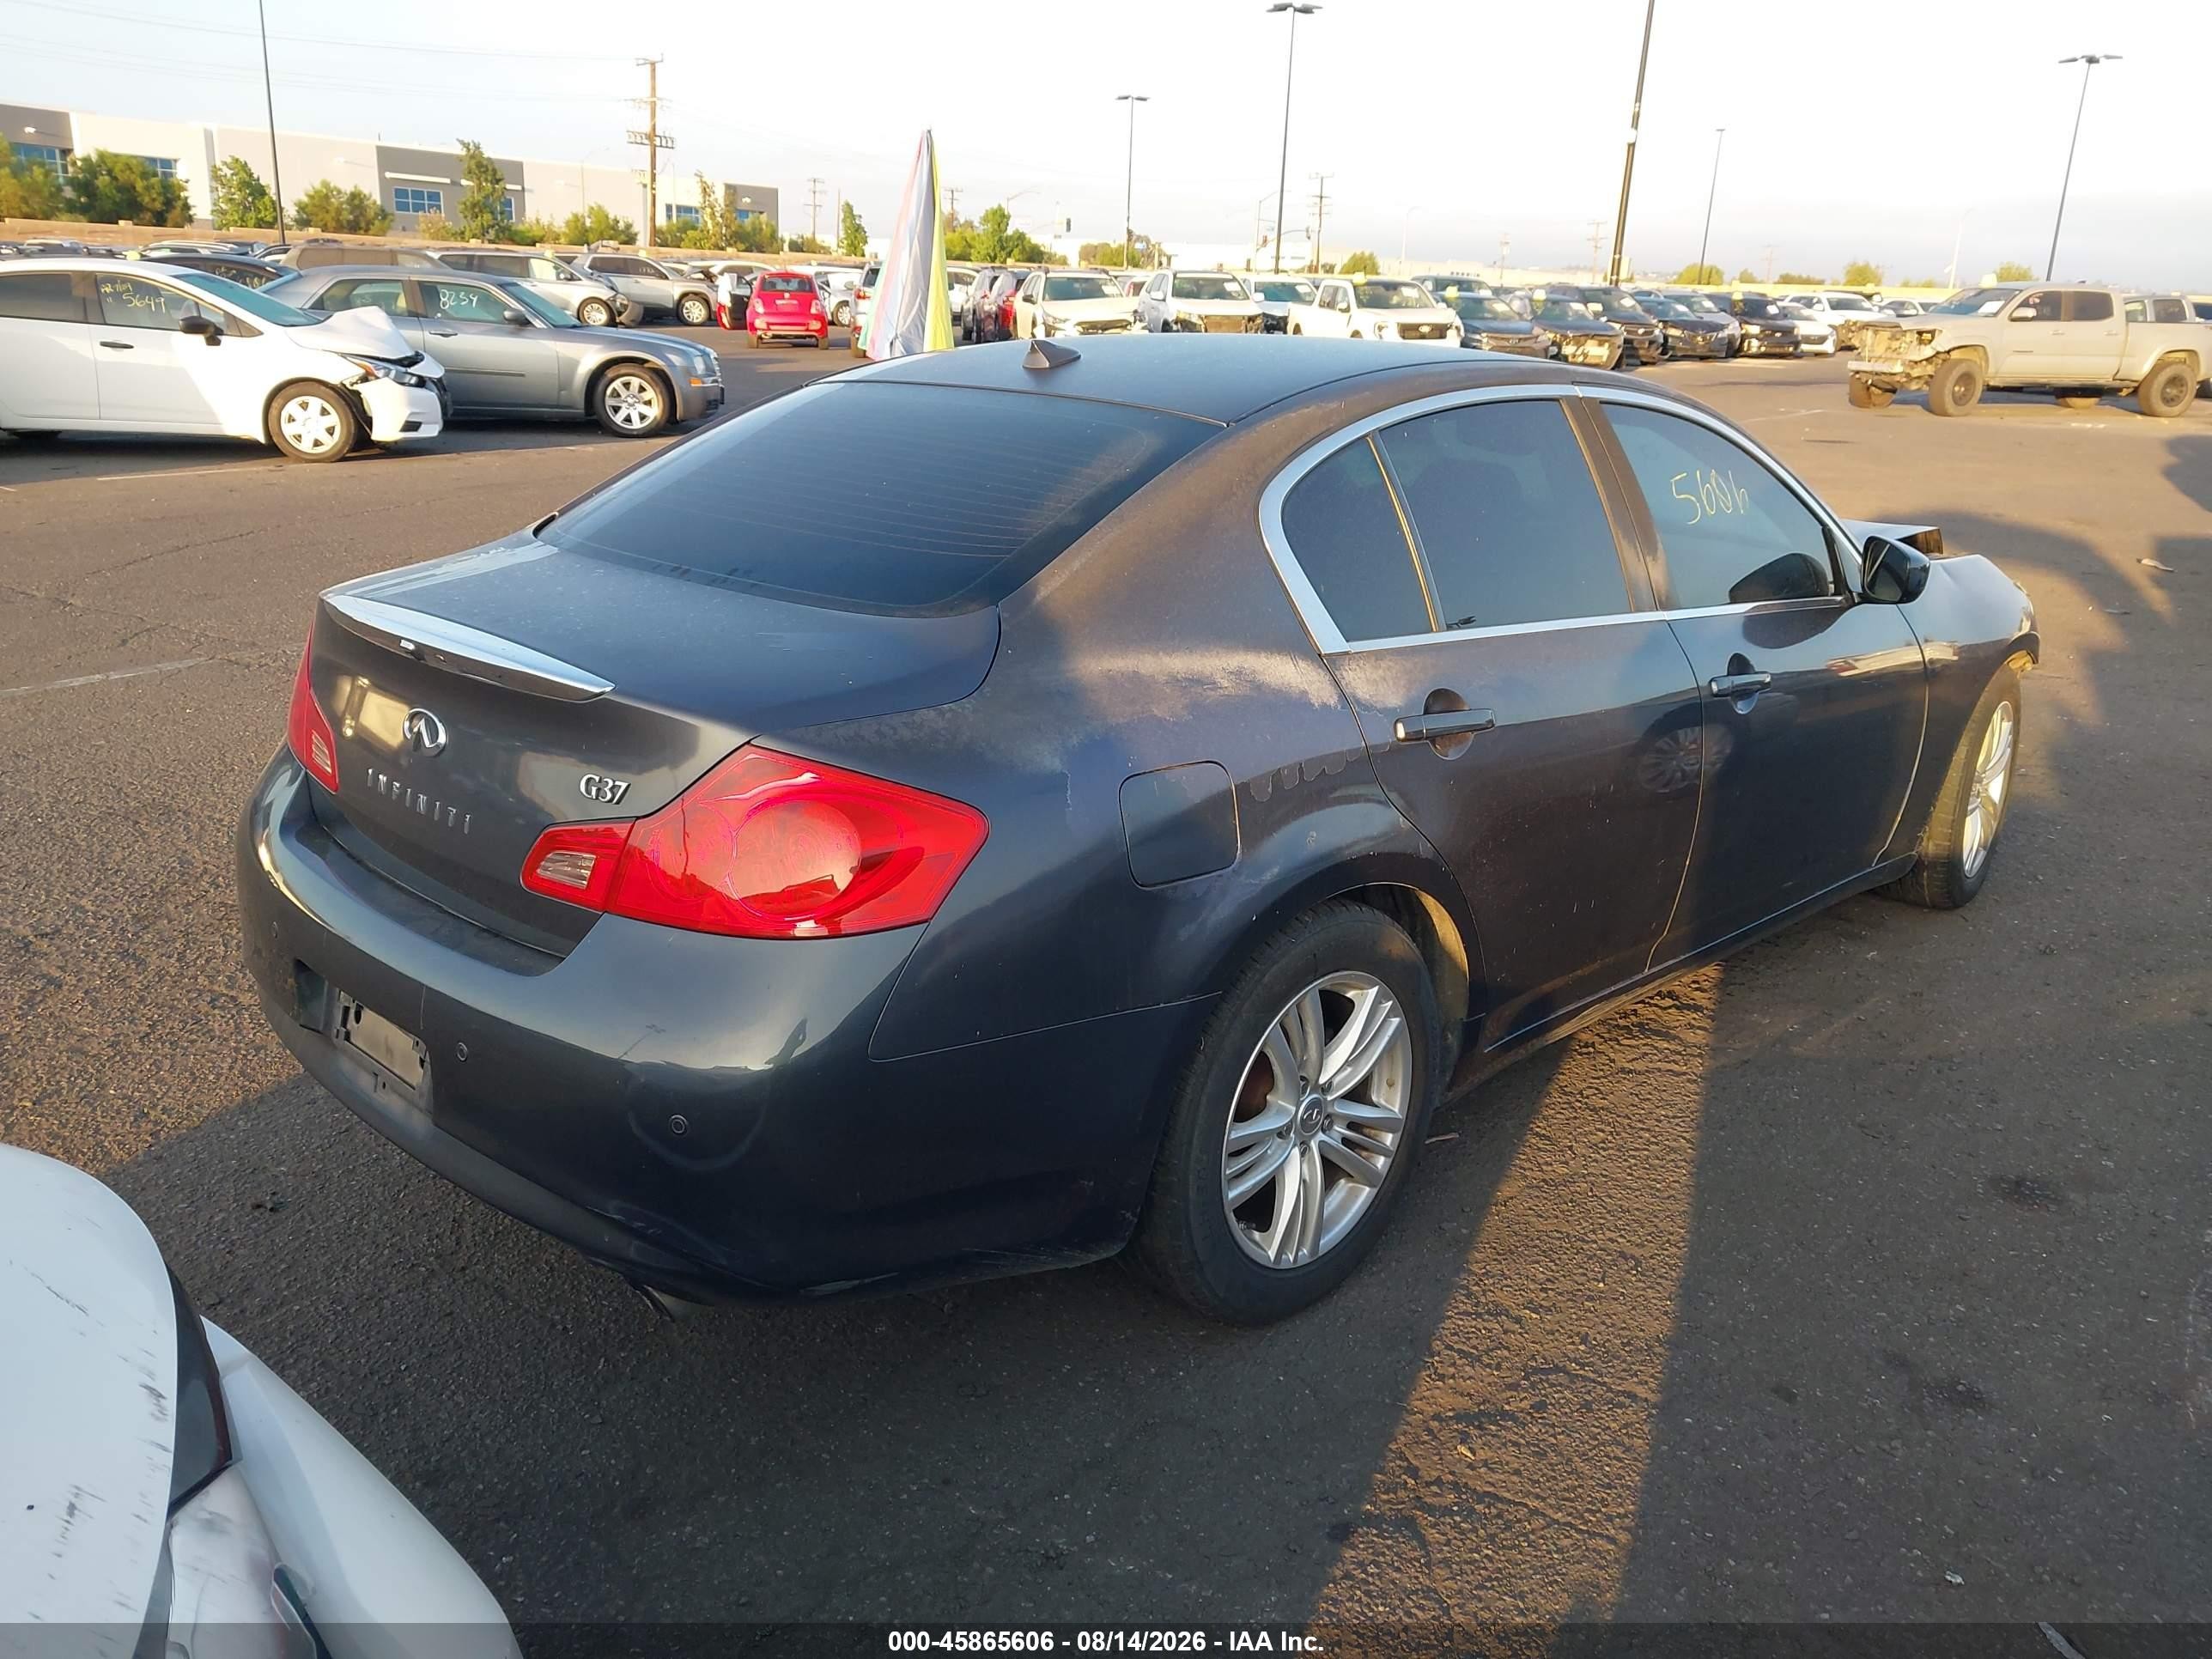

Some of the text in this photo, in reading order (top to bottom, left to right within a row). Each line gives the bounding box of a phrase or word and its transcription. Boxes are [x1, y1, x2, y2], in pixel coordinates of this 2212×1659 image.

[123, 292, 166, 313] 5649
[367, 769, 471, 835] INFINITI
[580, 774, 631, 805] G37
